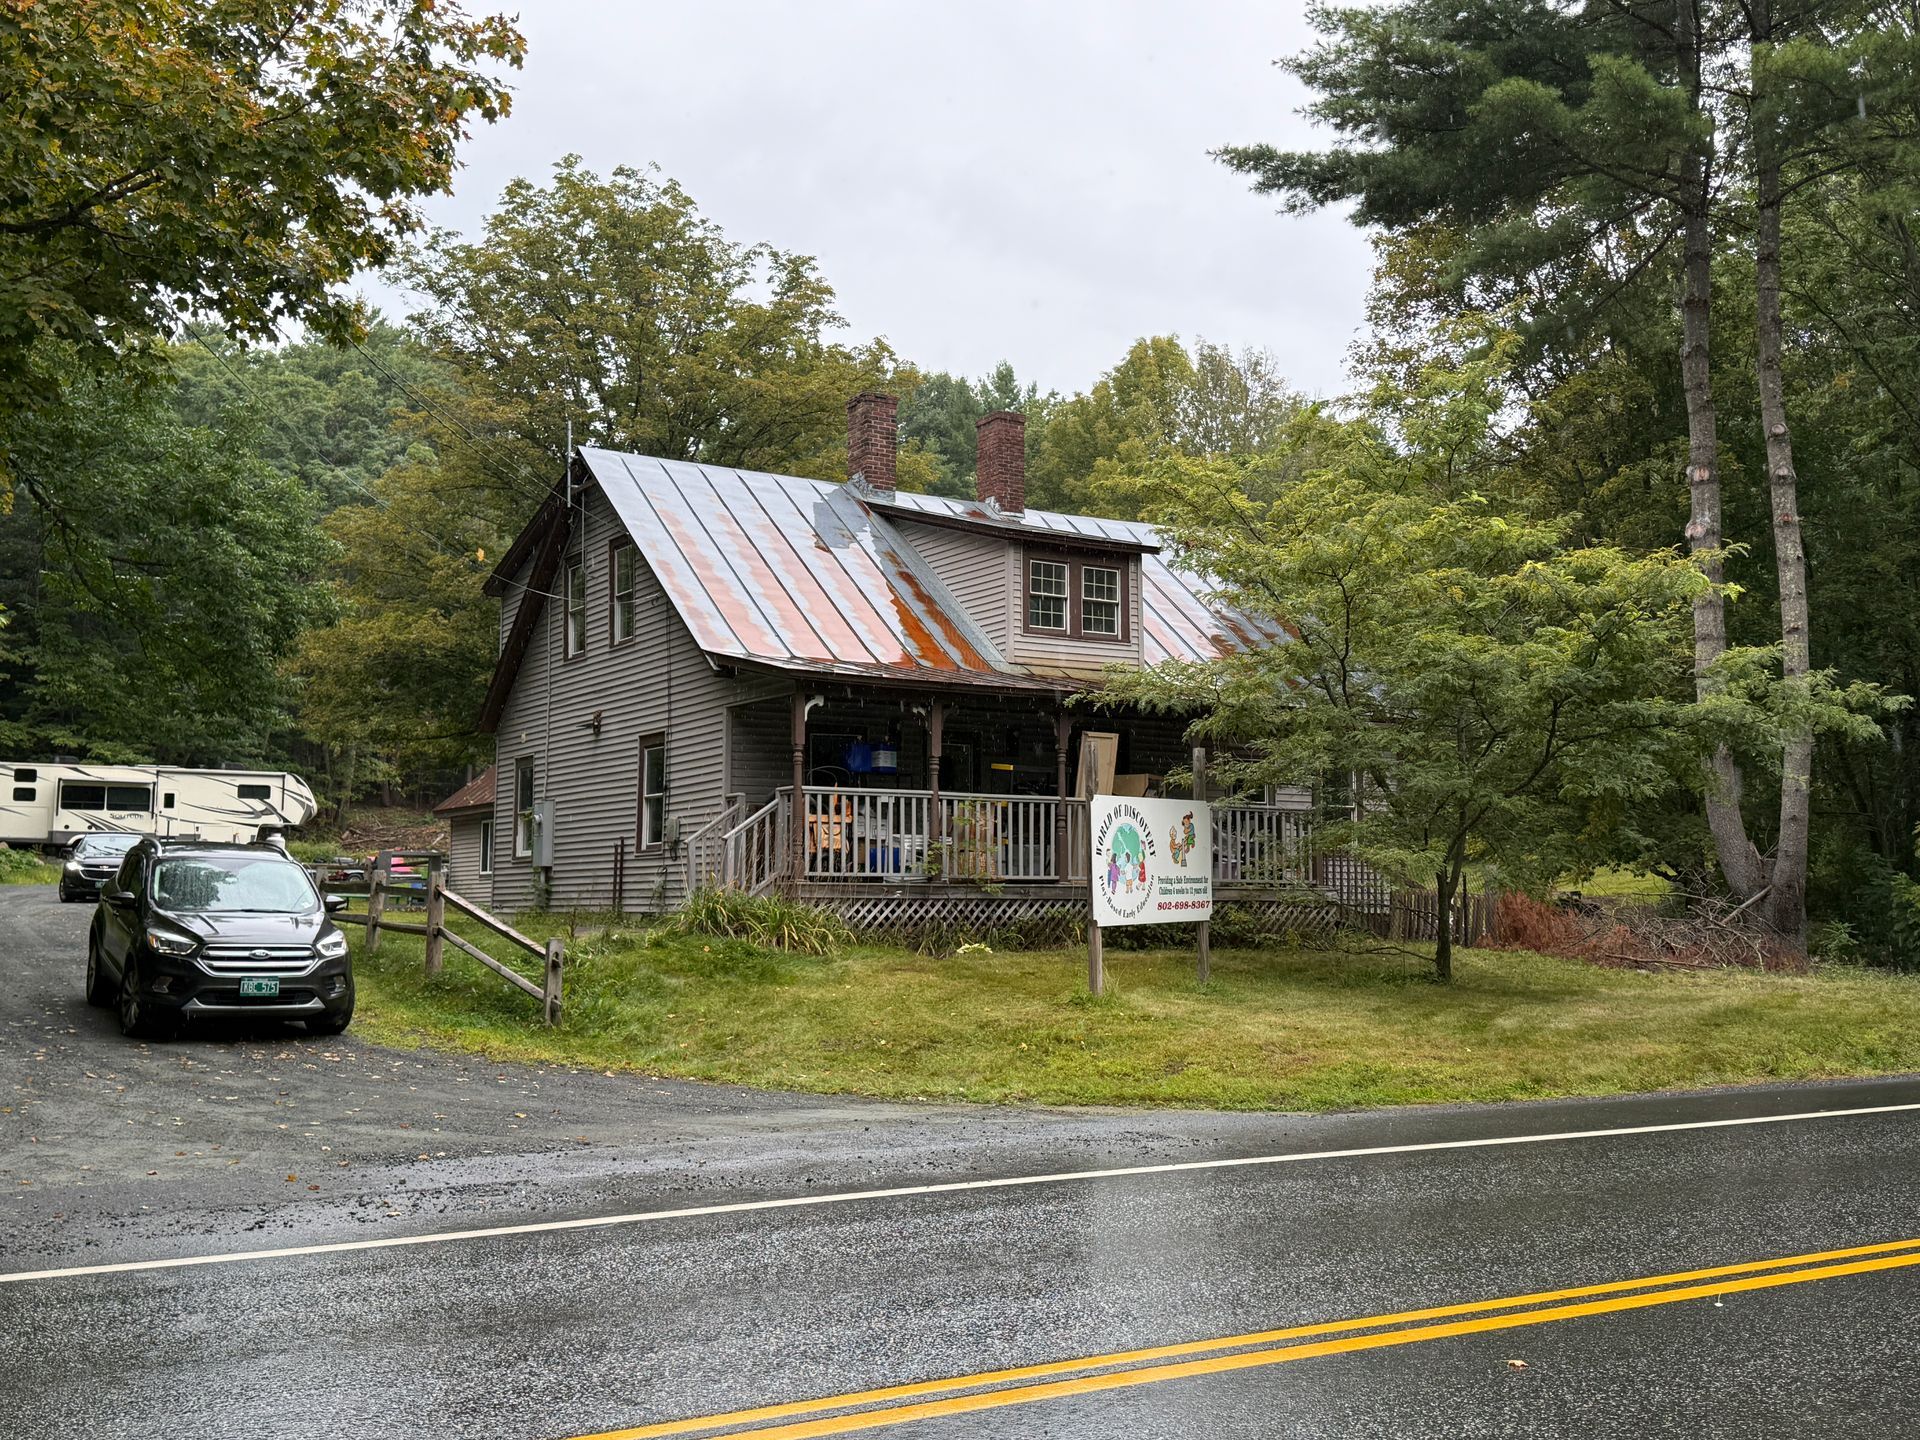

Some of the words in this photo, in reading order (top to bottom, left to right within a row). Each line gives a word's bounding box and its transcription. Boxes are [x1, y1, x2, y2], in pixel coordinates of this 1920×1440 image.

[1096, 813, 1113, 856] WORLD
[1113, 804, 1122, 819] OF
[1124, 804, 1156, 857] DISCOVERY
[1157, 876, 1173, 886] Providing
[1183, 875, 1203, 884] Environment
[1123, 909, 1136, 919] Early
[1136, 874, 1154, 914] Education
[1159, 886, 1172, 895] Children
[1176, 886, 1185, 895] weeks
[1193, 887, 1202, 896] years
[1157, 900, 1211, 910] 802-698-8367
